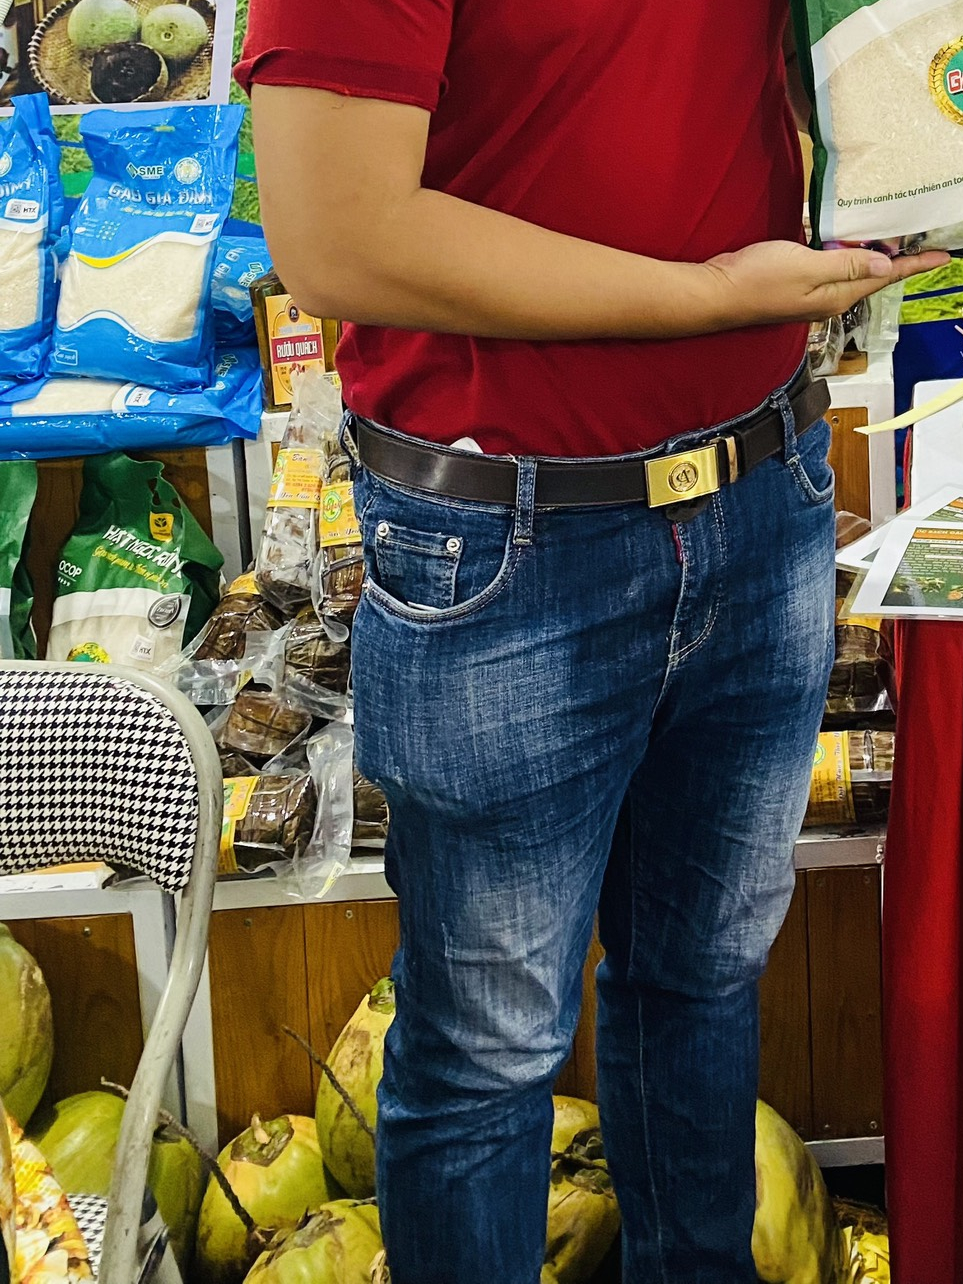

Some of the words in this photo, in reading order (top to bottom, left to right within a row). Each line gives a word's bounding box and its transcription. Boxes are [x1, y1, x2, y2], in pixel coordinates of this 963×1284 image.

[139, 165, 163, 176] SME
[836, 197, 853, 208] Quy
[873, 193, 893, 203] canh
[894, 190, 907, 200] tác
[907, 188, 918, 200] tự
[918, 182, 942, 195] nhiên
[942, 180, 953, 189] an
[58, 559, 82, 578] OCOP
